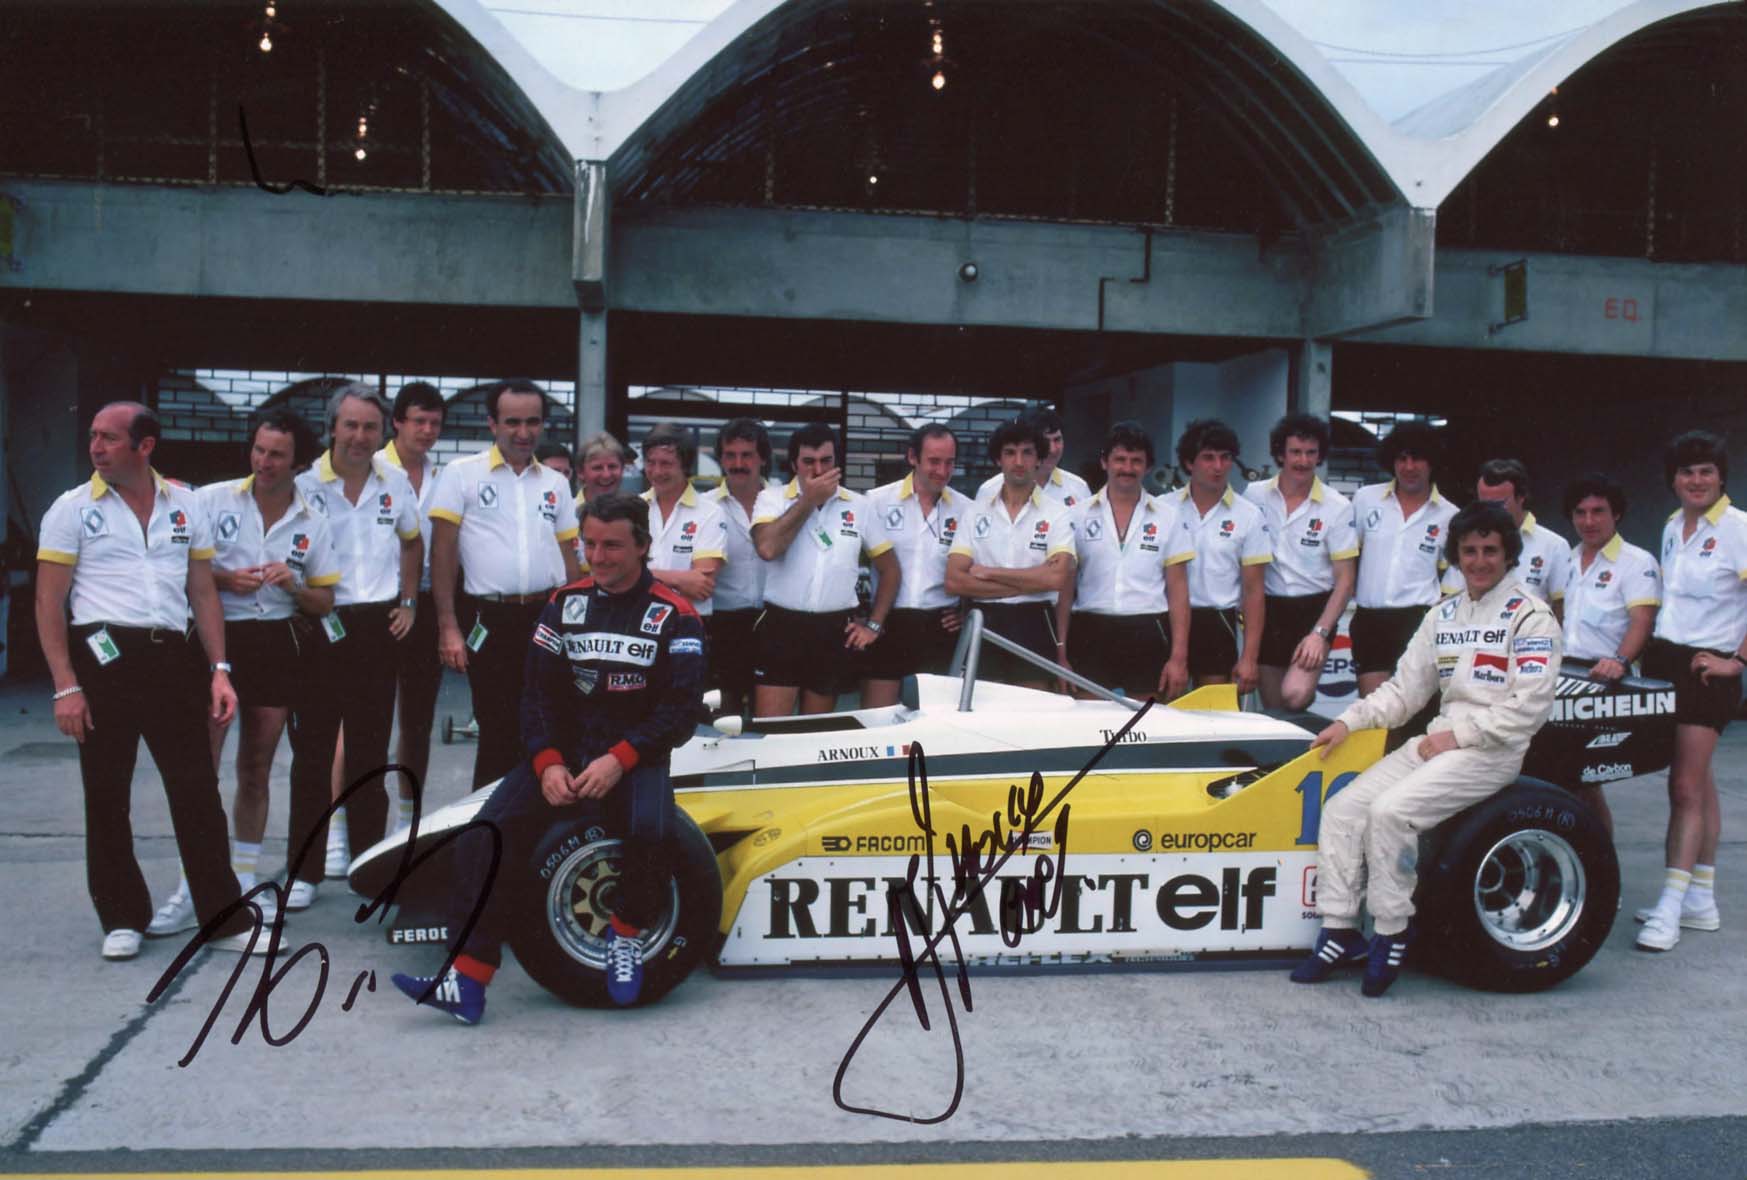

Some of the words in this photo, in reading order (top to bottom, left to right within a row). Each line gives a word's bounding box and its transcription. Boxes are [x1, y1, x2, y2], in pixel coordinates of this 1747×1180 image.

[643, 623, 660, 633] elf
[1483, 630, 1507, 643] elf
[627, 642, 655, 660] elf
[1549, 691, 1677, 722] MICHELIN
[1099, 729, 1147, 743] Trbo
[817, 745, 880, 761] ARNOUX
[856, 836, 925, 852] FACOM
[1160, 831, 1257, 853] europcar
[762, 873, 1149, 939] RENAULT
[1156, 867, 1277, 931] elf
